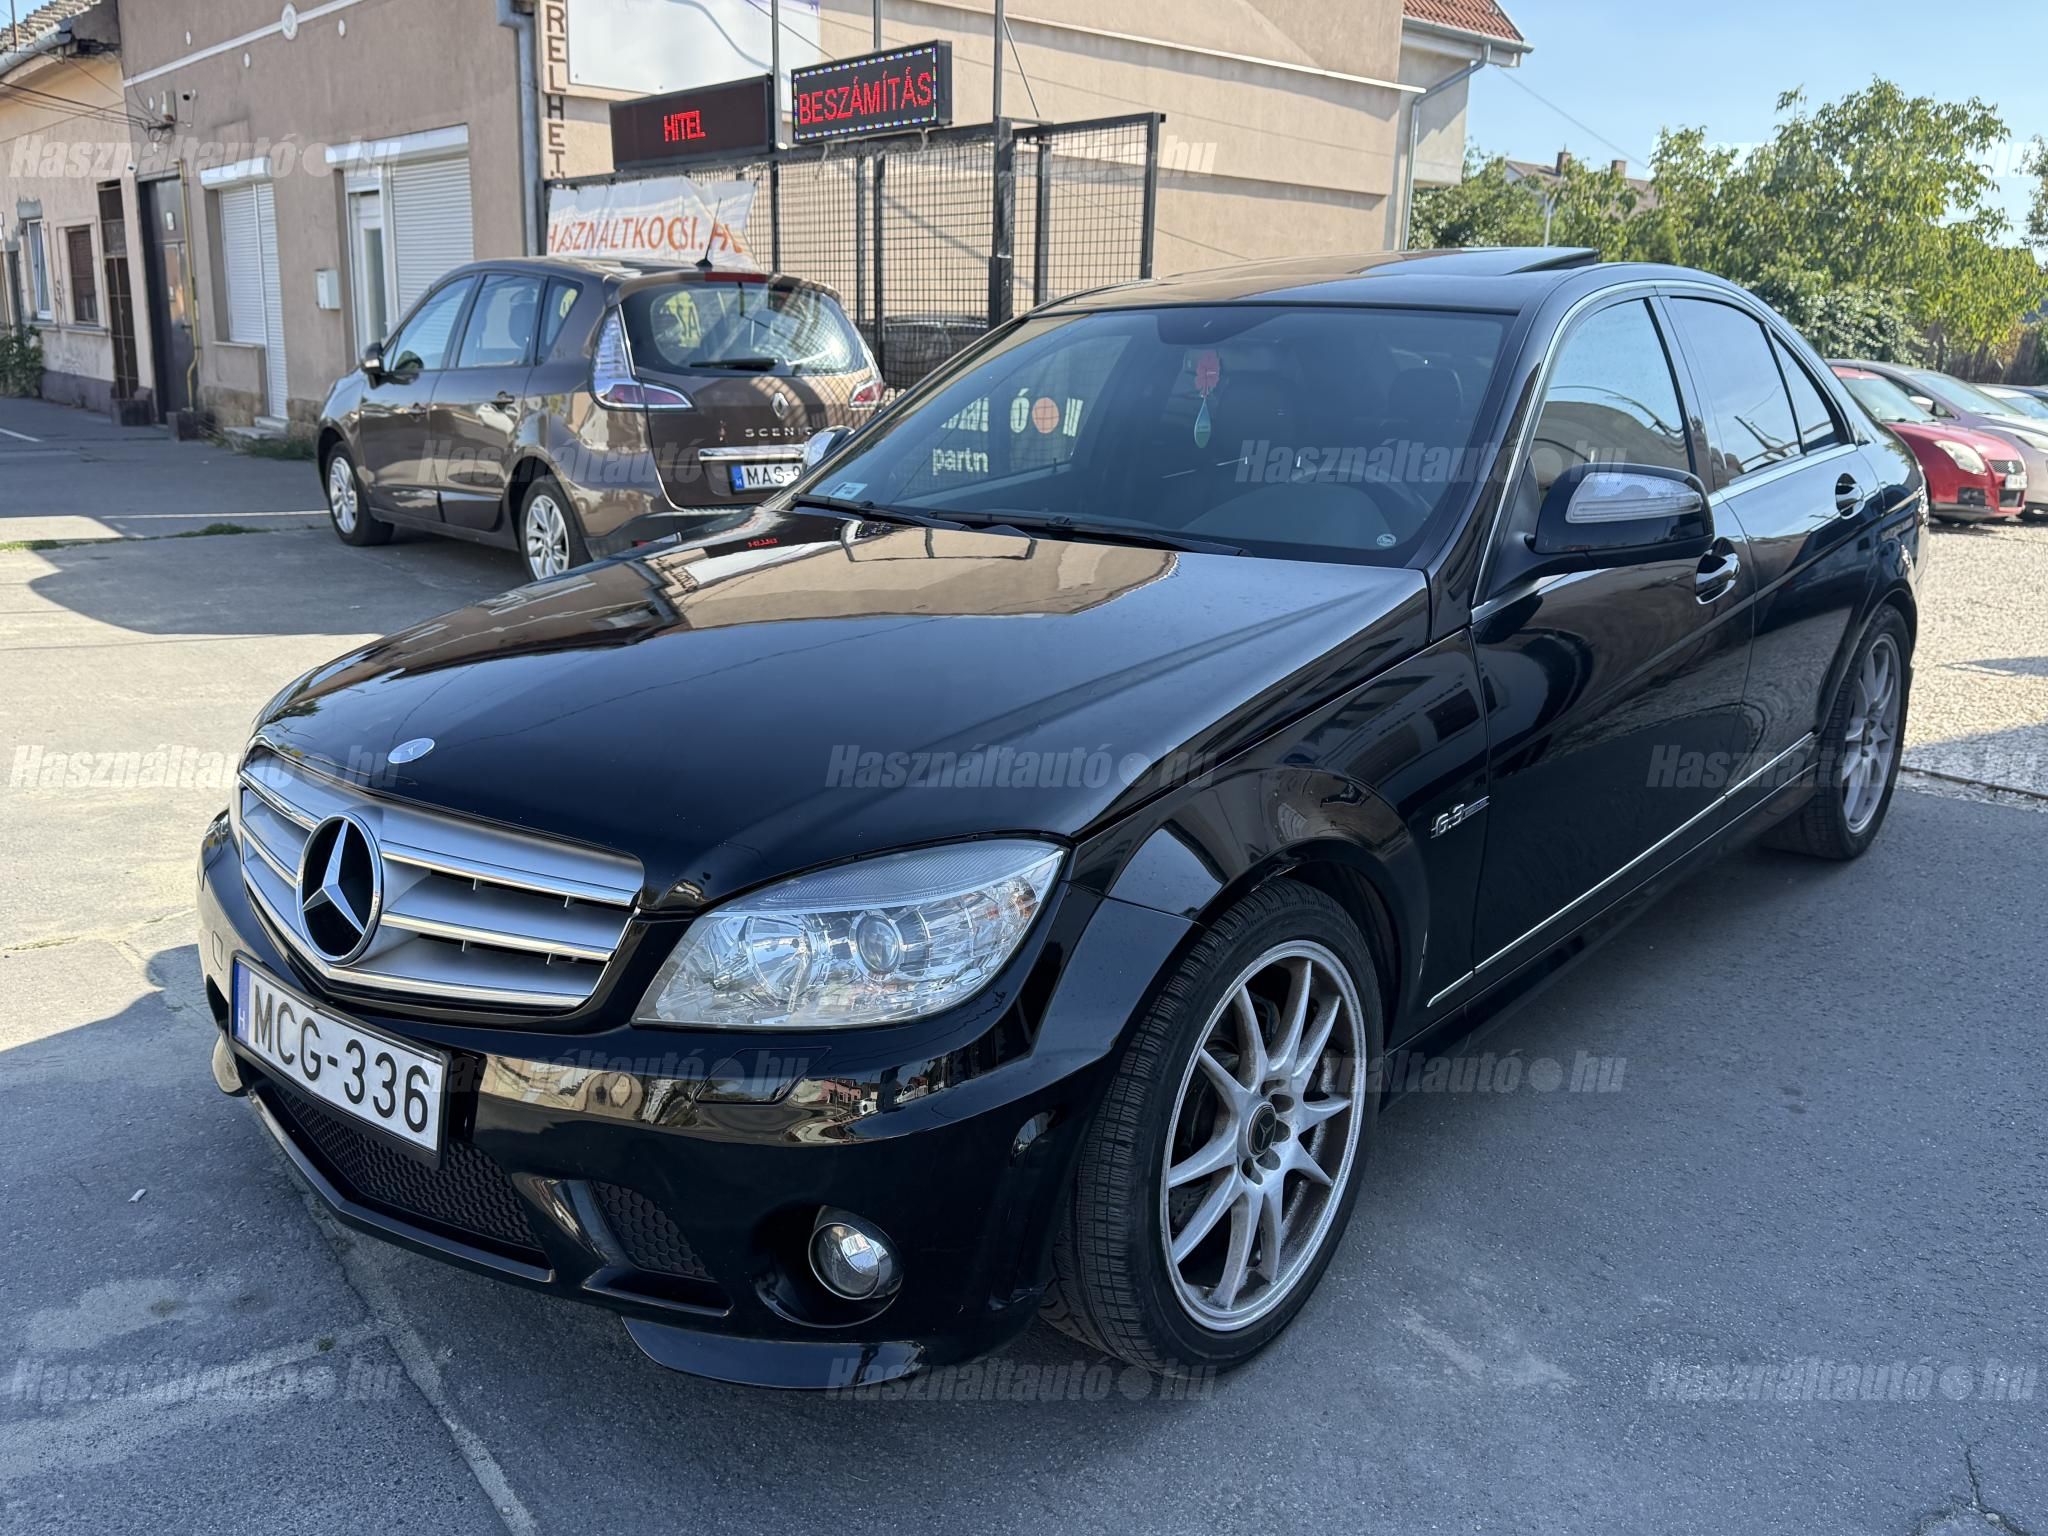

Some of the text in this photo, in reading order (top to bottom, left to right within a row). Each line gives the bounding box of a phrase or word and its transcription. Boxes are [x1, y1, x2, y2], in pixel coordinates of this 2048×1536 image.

[799, 66, 932, 125] BESZÁMÍTÁS
[664, 110, 706, 142] HITEL
[254, 984, 430, 1133] MCG-336
